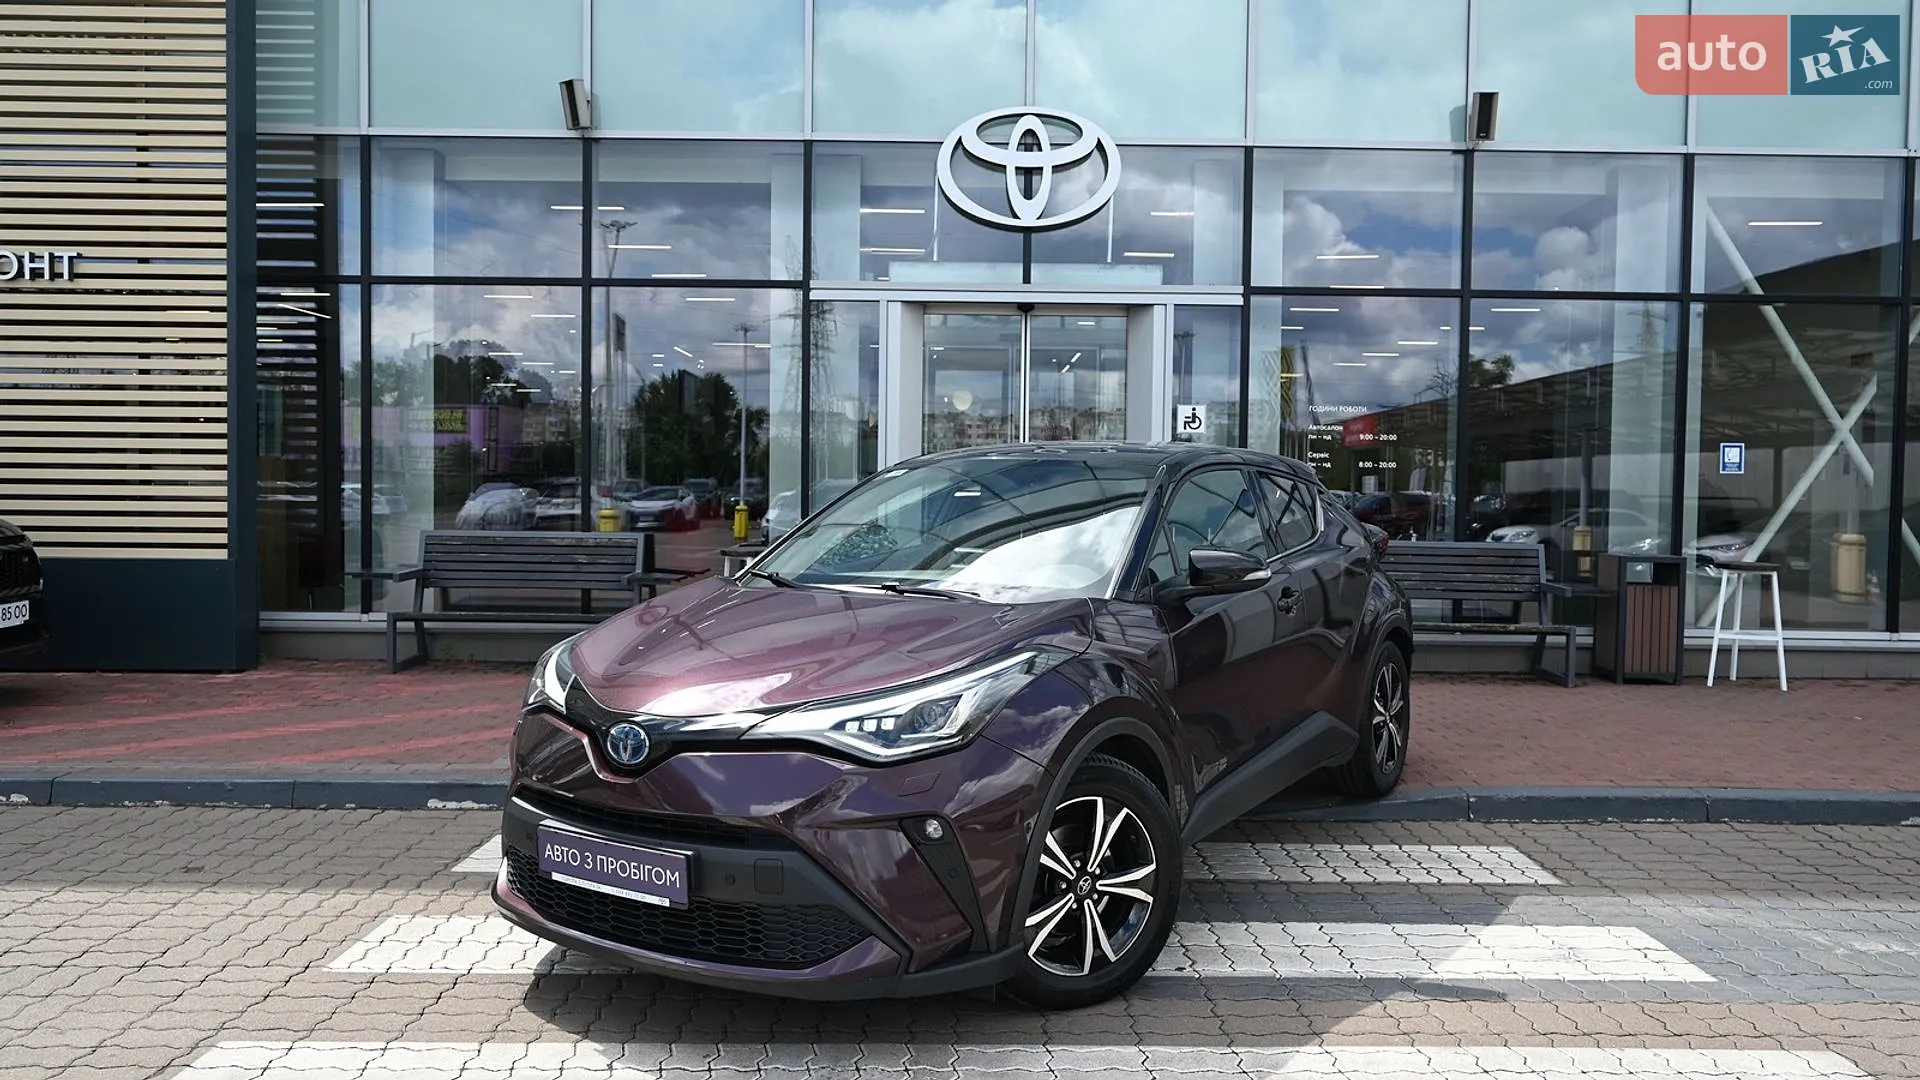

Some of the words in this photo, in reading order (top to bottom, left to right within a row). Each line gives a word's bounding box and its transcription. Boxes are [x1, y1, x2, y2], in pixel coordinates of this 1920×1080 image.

[1339, 405, 1367, 413] РОБОТИ
[1380, 433, 1398, 441] 20:00
[544, 843, 581, 866] АВТО
[597, 855, 680, 888] ПРОБІГОМ
